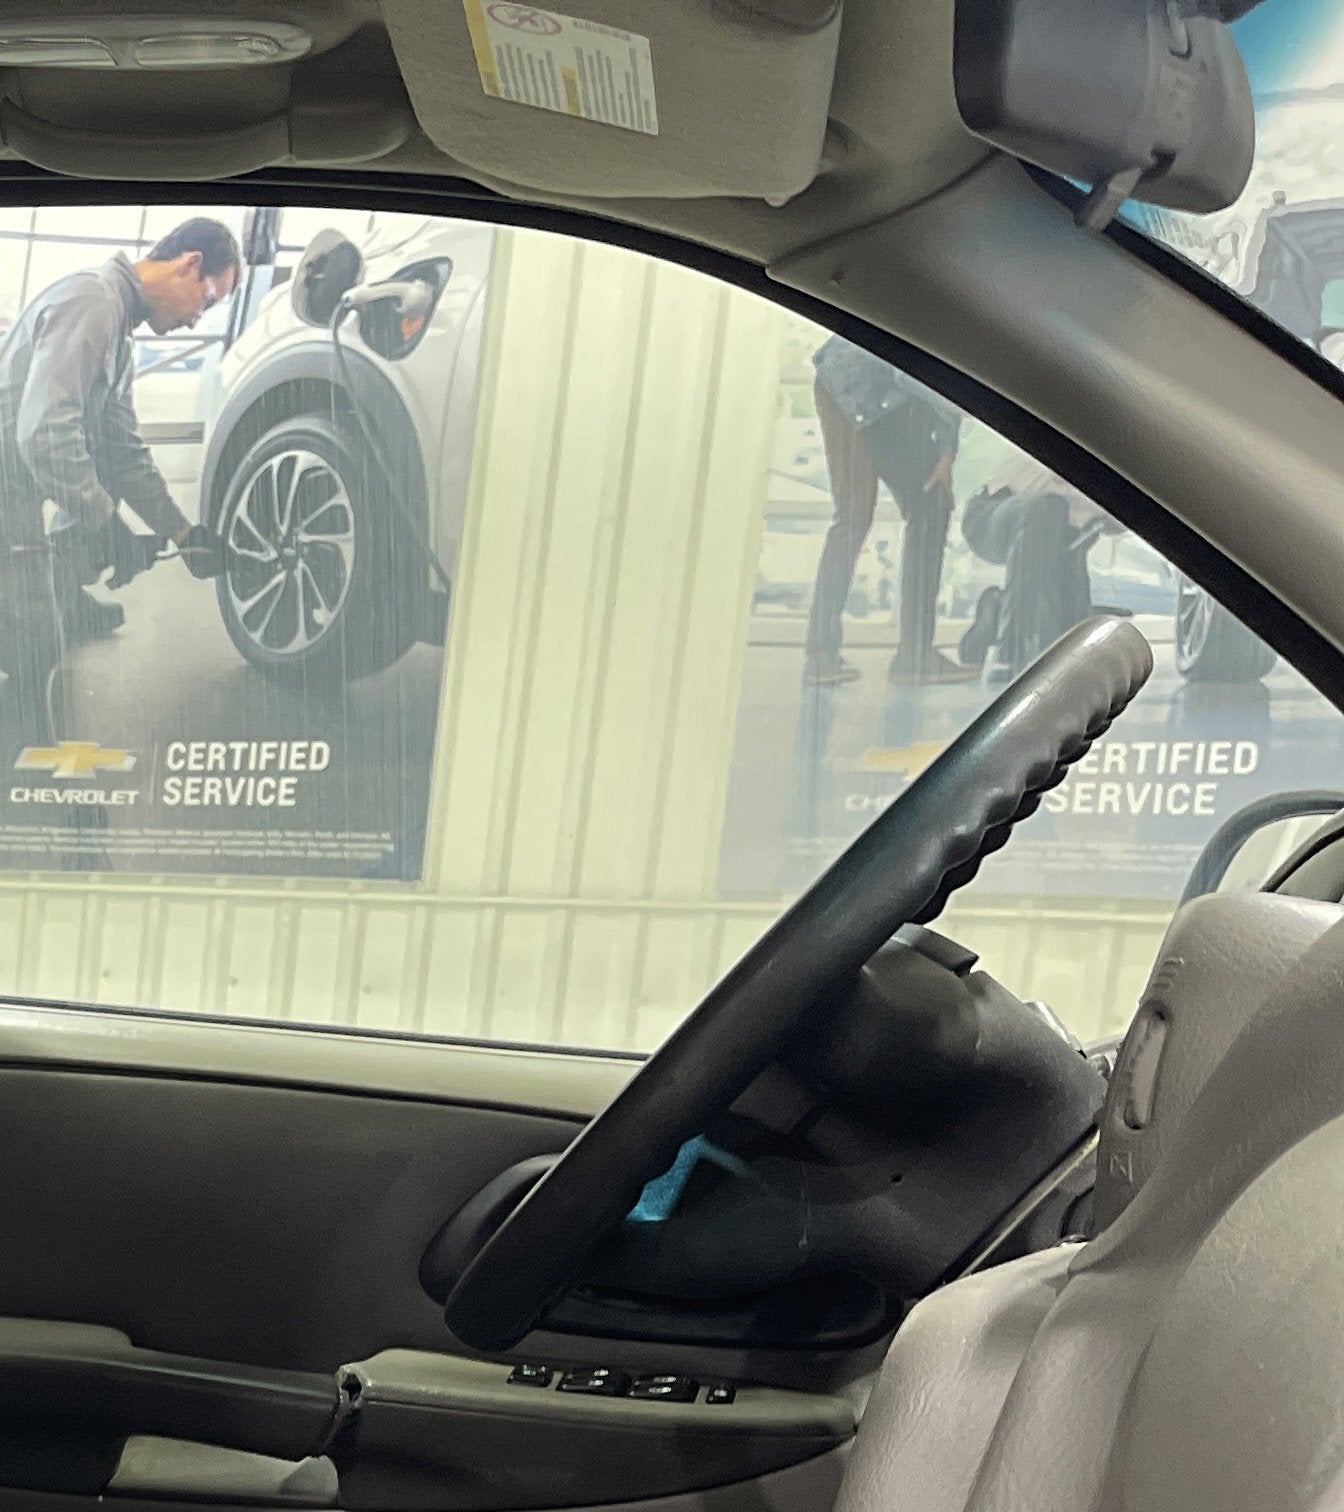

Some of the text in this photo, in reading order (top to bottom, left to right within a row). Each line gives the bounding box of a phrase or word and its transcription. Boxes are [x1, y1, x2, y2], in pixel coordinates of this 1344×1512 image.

[167, 741, 329, 772] CERTIFIED
[1078, 742, 1259, 776] ERTIFIED
[10, 787, 140, 804] CHEVROLET
[162, 776, 298, 807] SERVICE
[1045, 782, 1218, 815] SERVICE
